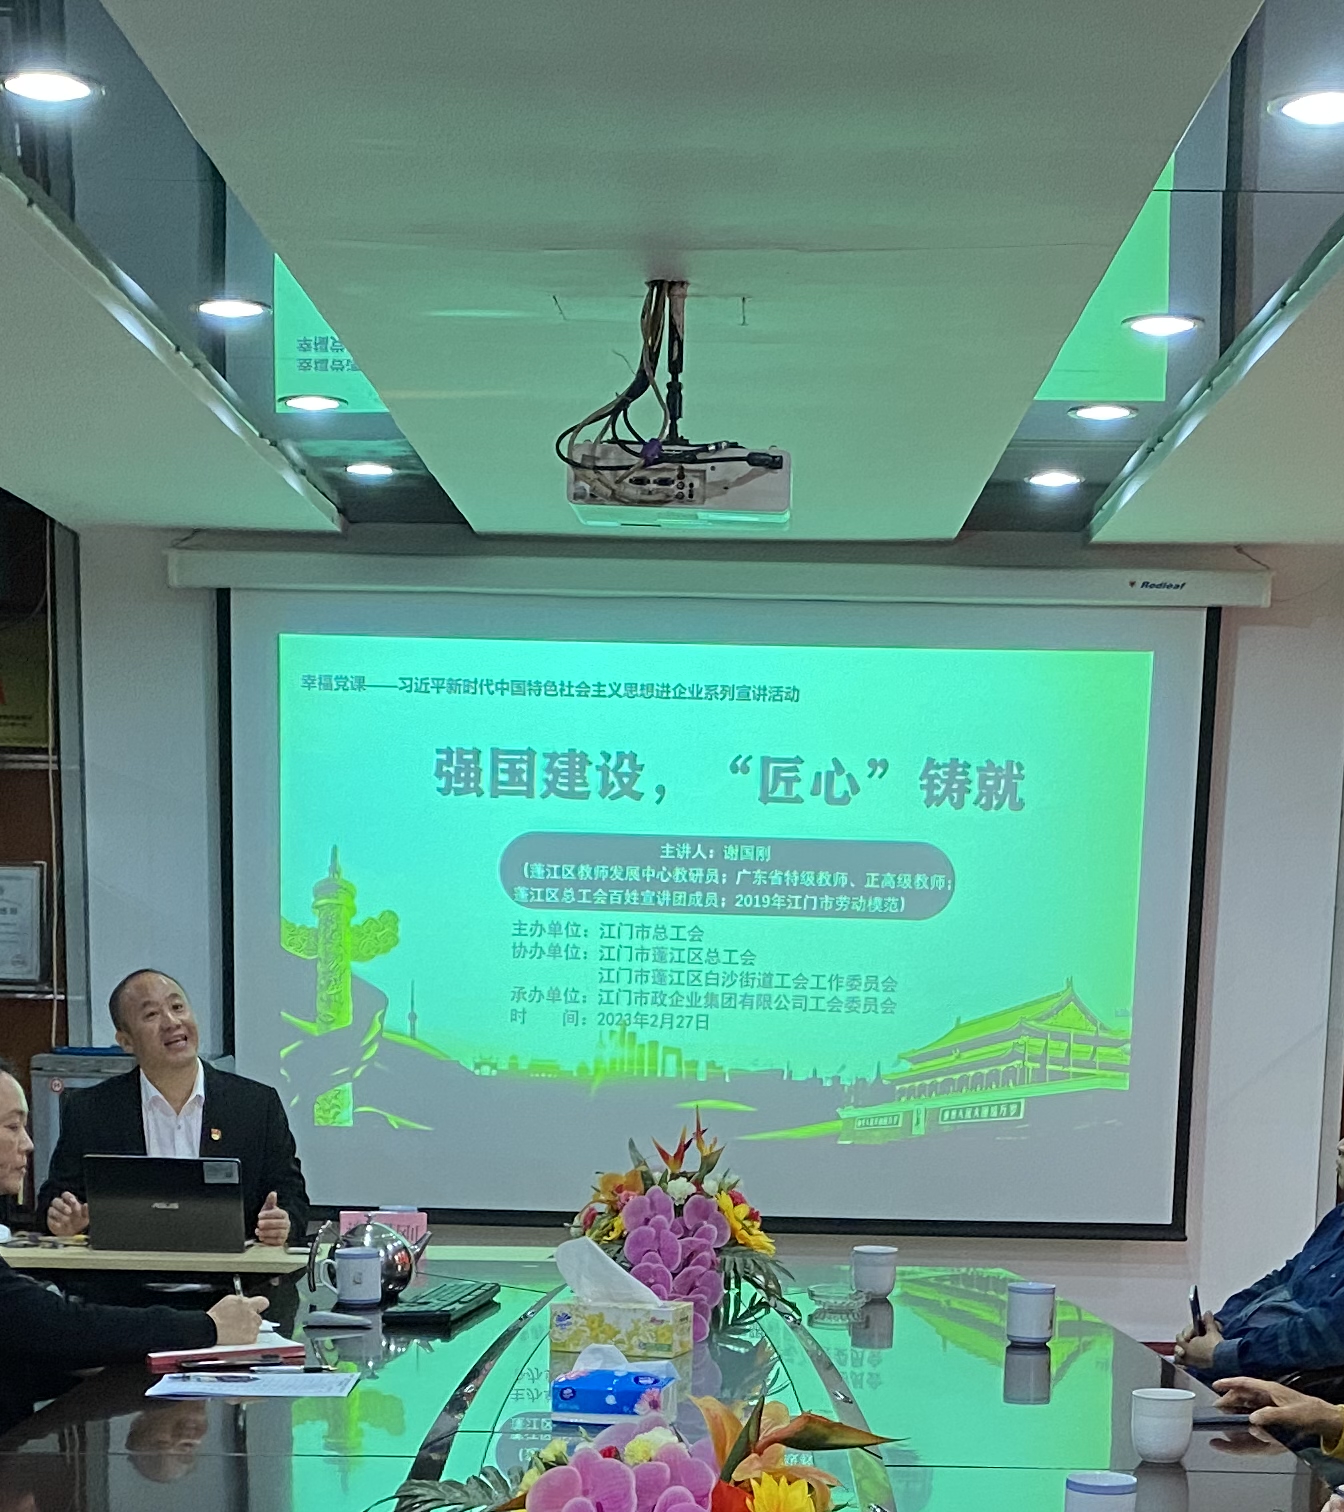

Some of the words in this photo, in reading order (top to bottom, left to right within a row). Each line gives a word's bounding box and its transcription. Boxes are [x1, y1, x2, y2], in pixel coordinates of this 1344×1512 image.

[301, 674, 800, 703] 幸福党课——习近平新时代中国特色社会主义思想进企业系列宣讲活动
[660, 843, 772, 863] 主讲人：谢国刚
[512, 920, 705, 943] 主办单位：江门市总工会
[512, 942, 756, 967] 协办单位：江门市蓬江区总工会
[598, 967, 898, 993] 江门市蓬江区白沙街道工会工作委员会
[511, 986, 897, 1015] 承办单位：江门市政企业集团有限公司工会委员会
